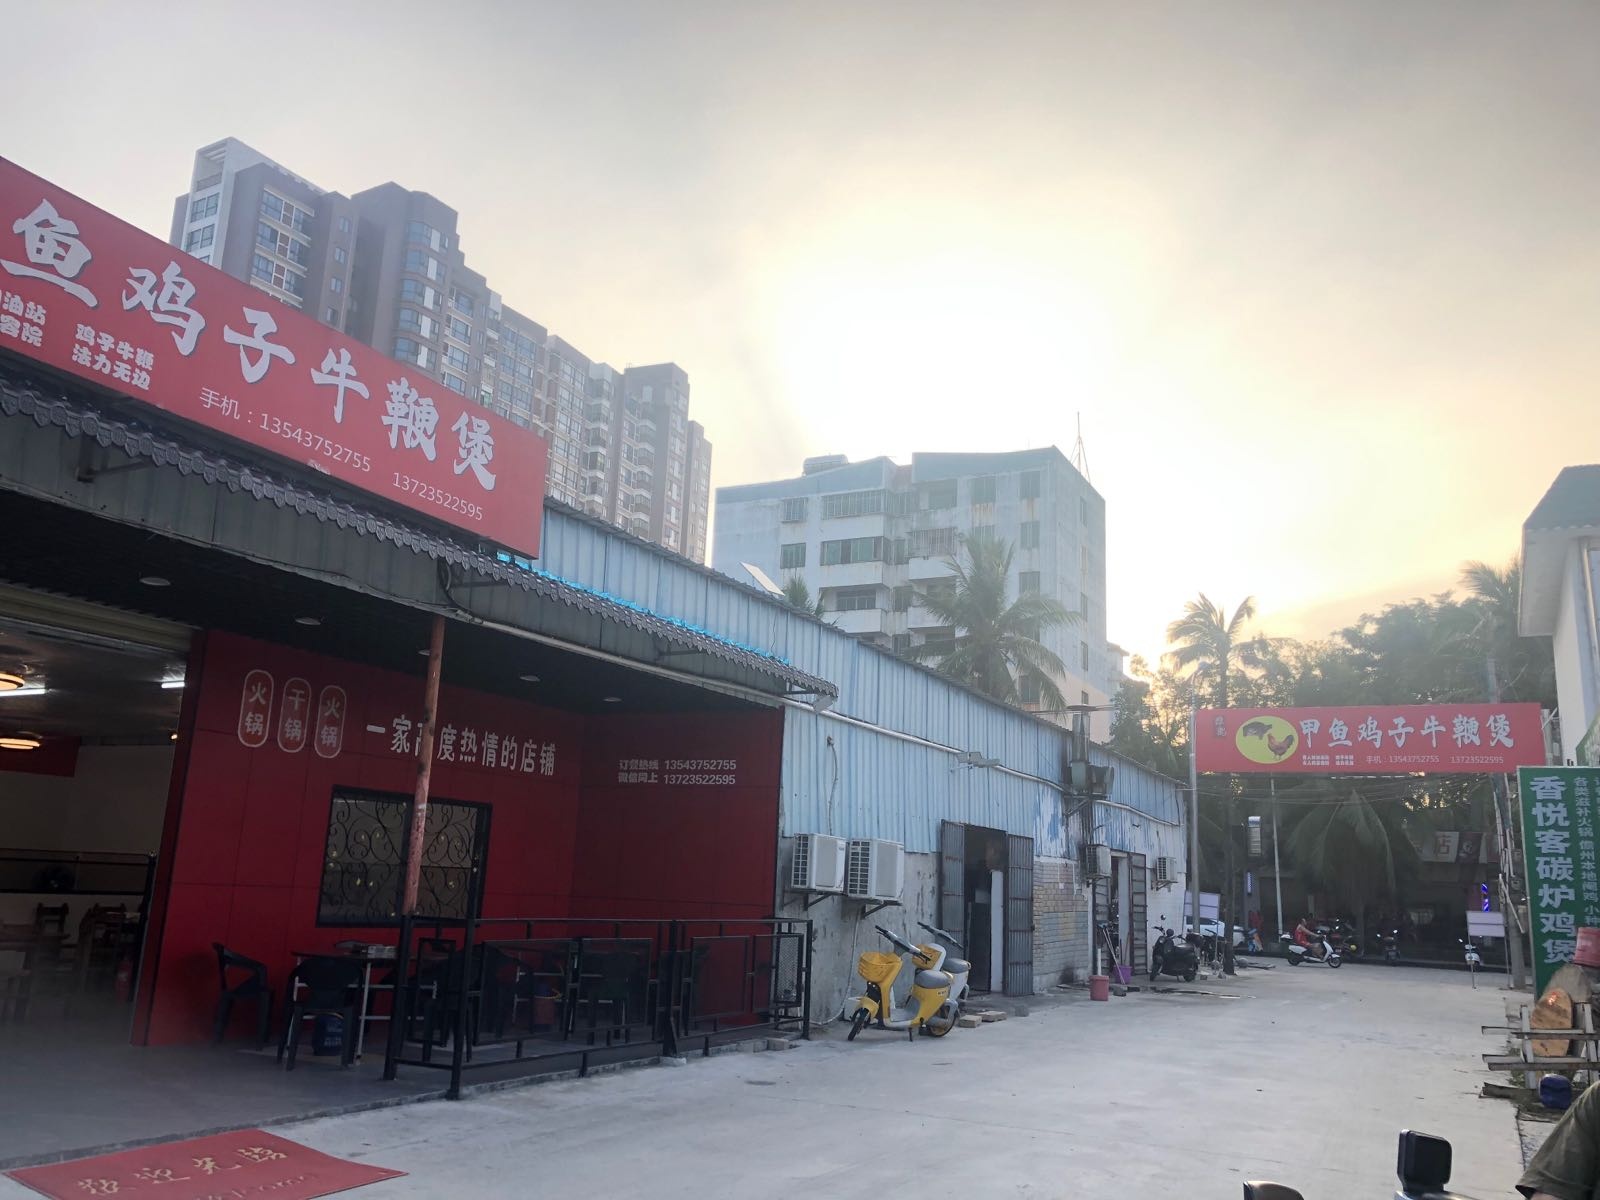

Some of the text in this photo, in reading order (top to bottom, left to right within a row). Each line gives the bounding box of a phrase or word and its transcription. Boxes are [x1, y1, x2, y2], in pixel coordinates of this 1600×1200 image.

[1, 199, 497, 491] 鱼鸡子牛鞭煲
[72, 343, 151, 390] 法力无边
[75, 323, 154, 370] 鸡子牛鞭
[392, 472, 483, 521] 13723522595
[245, 682, 267, 736] 火锅
[285, 688, 306, 741] 干锅
[321, 698, 341, 748] 火锅
[1299, 713, 1515, 749] 甲鱼鸡子牛鞭煲
[663, 774, 736, 785] 13723522595
[664, 760, 737, 770] 13543752755
[1529, 775, 1576, 964] 香悦客碳炉鸡煲
